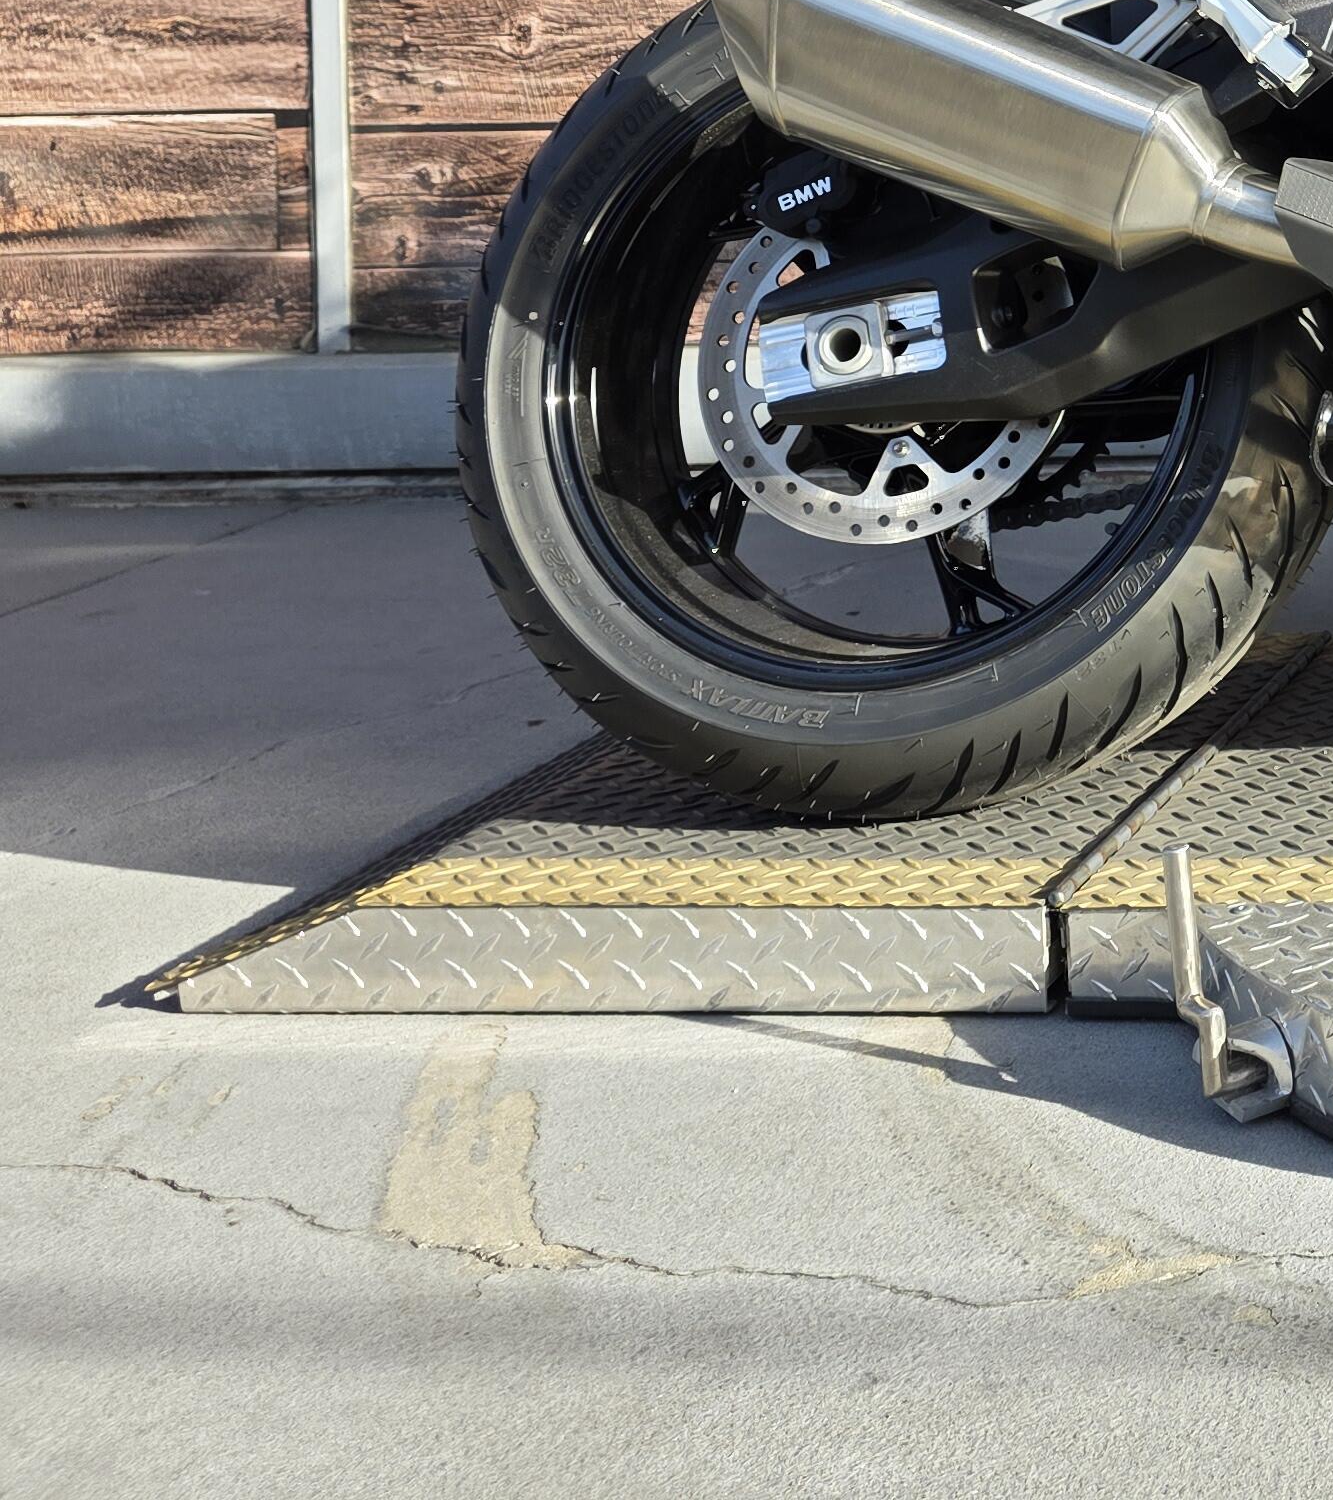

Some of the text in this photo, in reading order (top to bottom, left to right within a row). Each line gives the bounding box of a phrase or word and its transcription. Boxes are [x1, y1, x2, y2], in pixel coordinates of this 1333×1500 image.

[777, 174, 833, 213] BMW
[1091, 443, 1223, 633] BRIDGESTONE
[689, 678, 830, 729] BATTLAX
